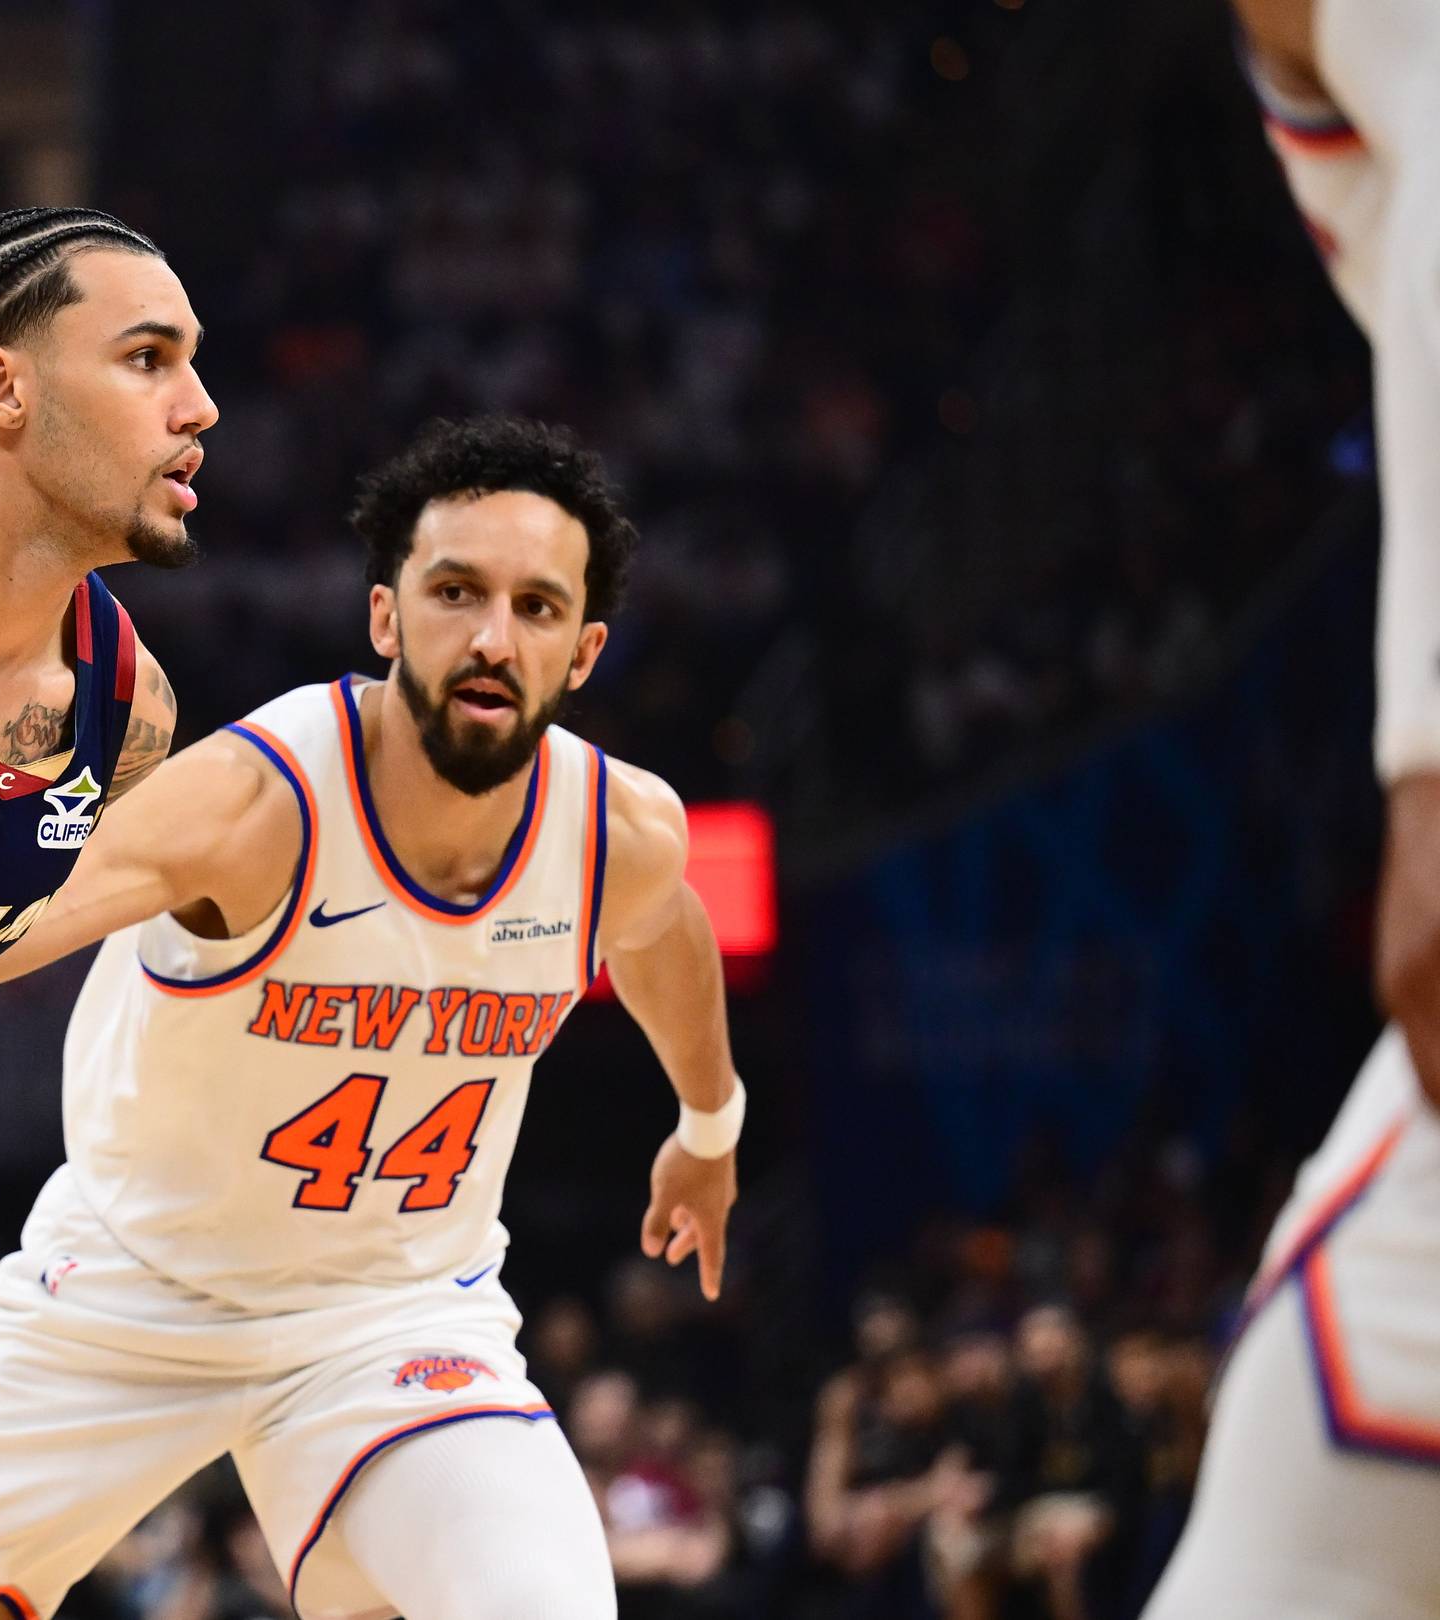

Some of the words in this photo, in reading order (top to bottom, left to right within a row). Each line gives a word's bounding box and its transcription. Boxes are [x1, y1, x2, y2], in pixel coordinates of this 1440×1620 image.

[40, 822, 91, 842] CLIFFS
[247, 978, 424, 1051] NEW
[423, 986, 574, 1057] YORK
[260, 1072, 497, 1213] 44
